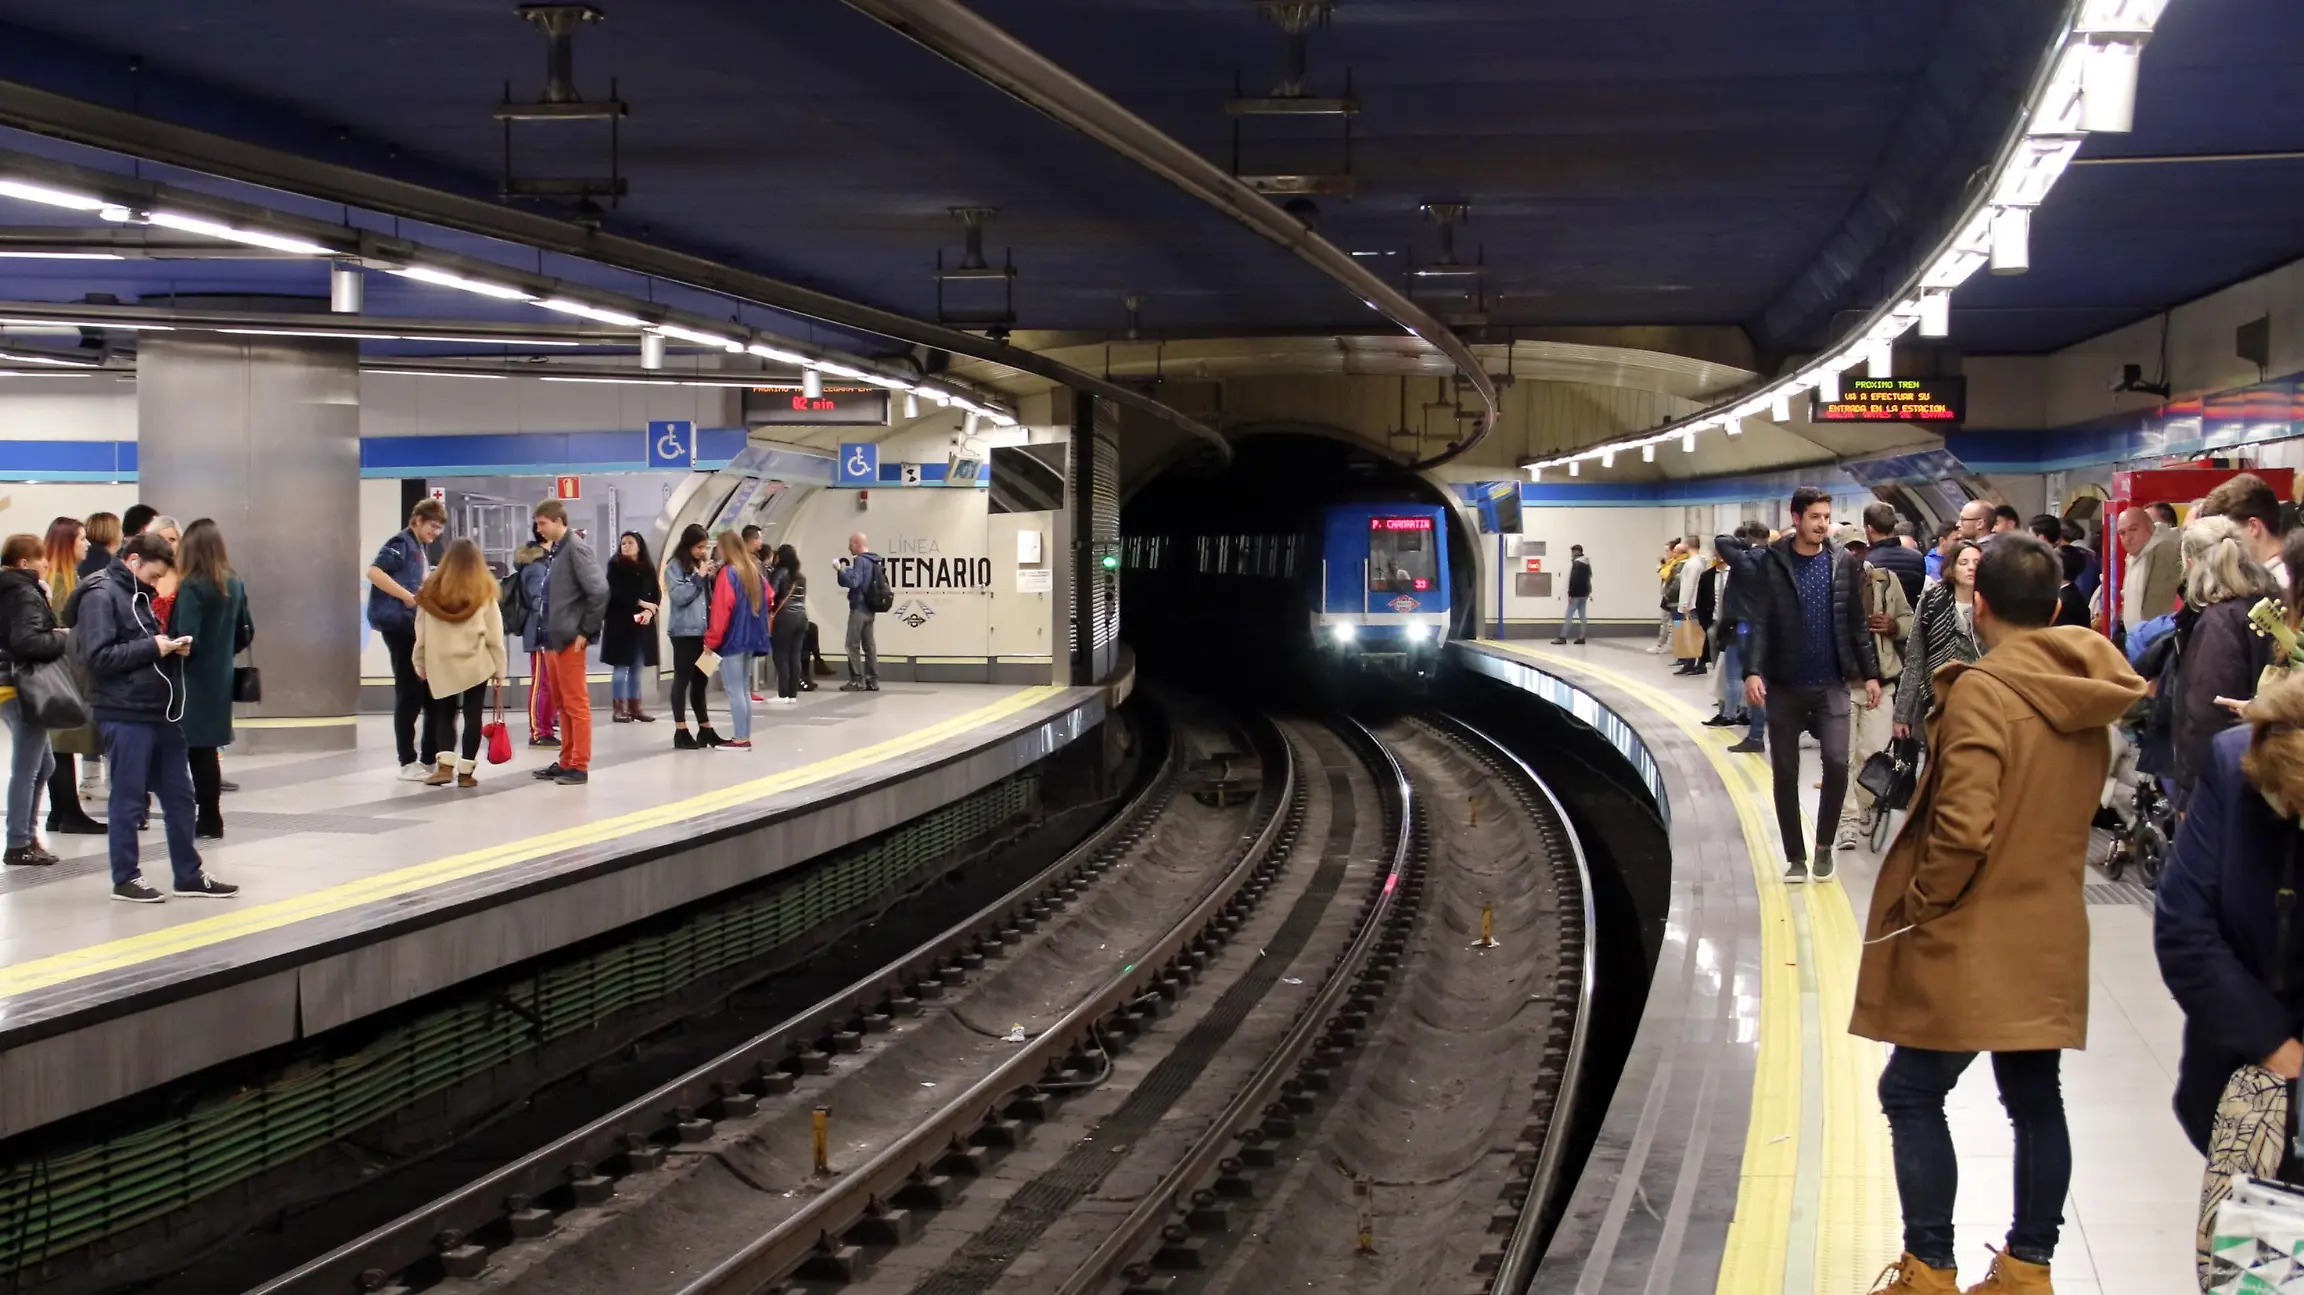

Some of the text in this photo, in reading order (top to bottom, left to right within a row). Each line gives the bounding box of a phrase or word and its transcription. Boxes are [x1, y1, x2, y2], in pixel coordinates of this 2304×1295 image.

[1855, 380, 1920, 389] PROXIMO TREN
[1844, 392, 1931, 401] VA A EFECTUAR SU
[812, 398, 834, 410] min
[1828, 404, 1946, 413] ENTRADA EN LA ESTACION
[888, 534, 940, 554] LÍNEA
[1415, 580, 1427, 589] 33
